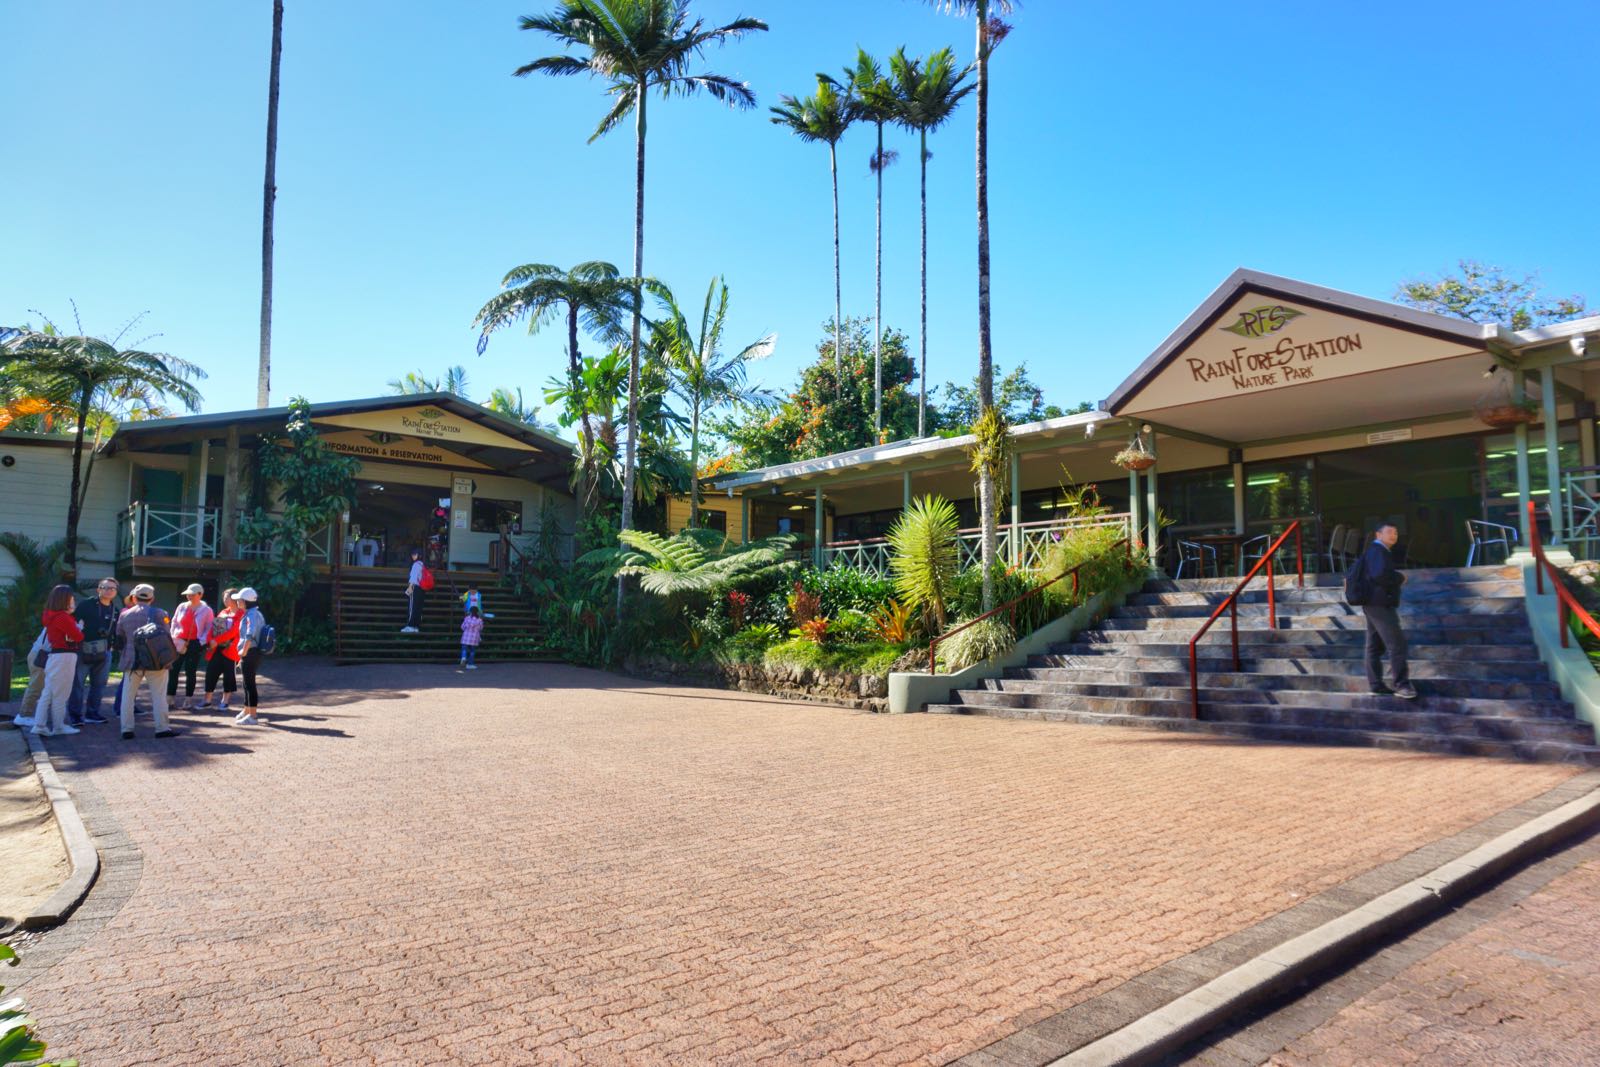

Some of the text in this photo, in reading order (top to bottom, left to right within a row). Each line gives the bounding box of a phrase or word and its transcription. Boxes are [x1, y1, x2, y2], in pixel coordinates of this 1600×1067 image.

[1239, 305, 1285, 336] RFS
[1232, 365, 1314, 390] NATURE PARK
[389, 449, 443, 462] RESERVATIONS
